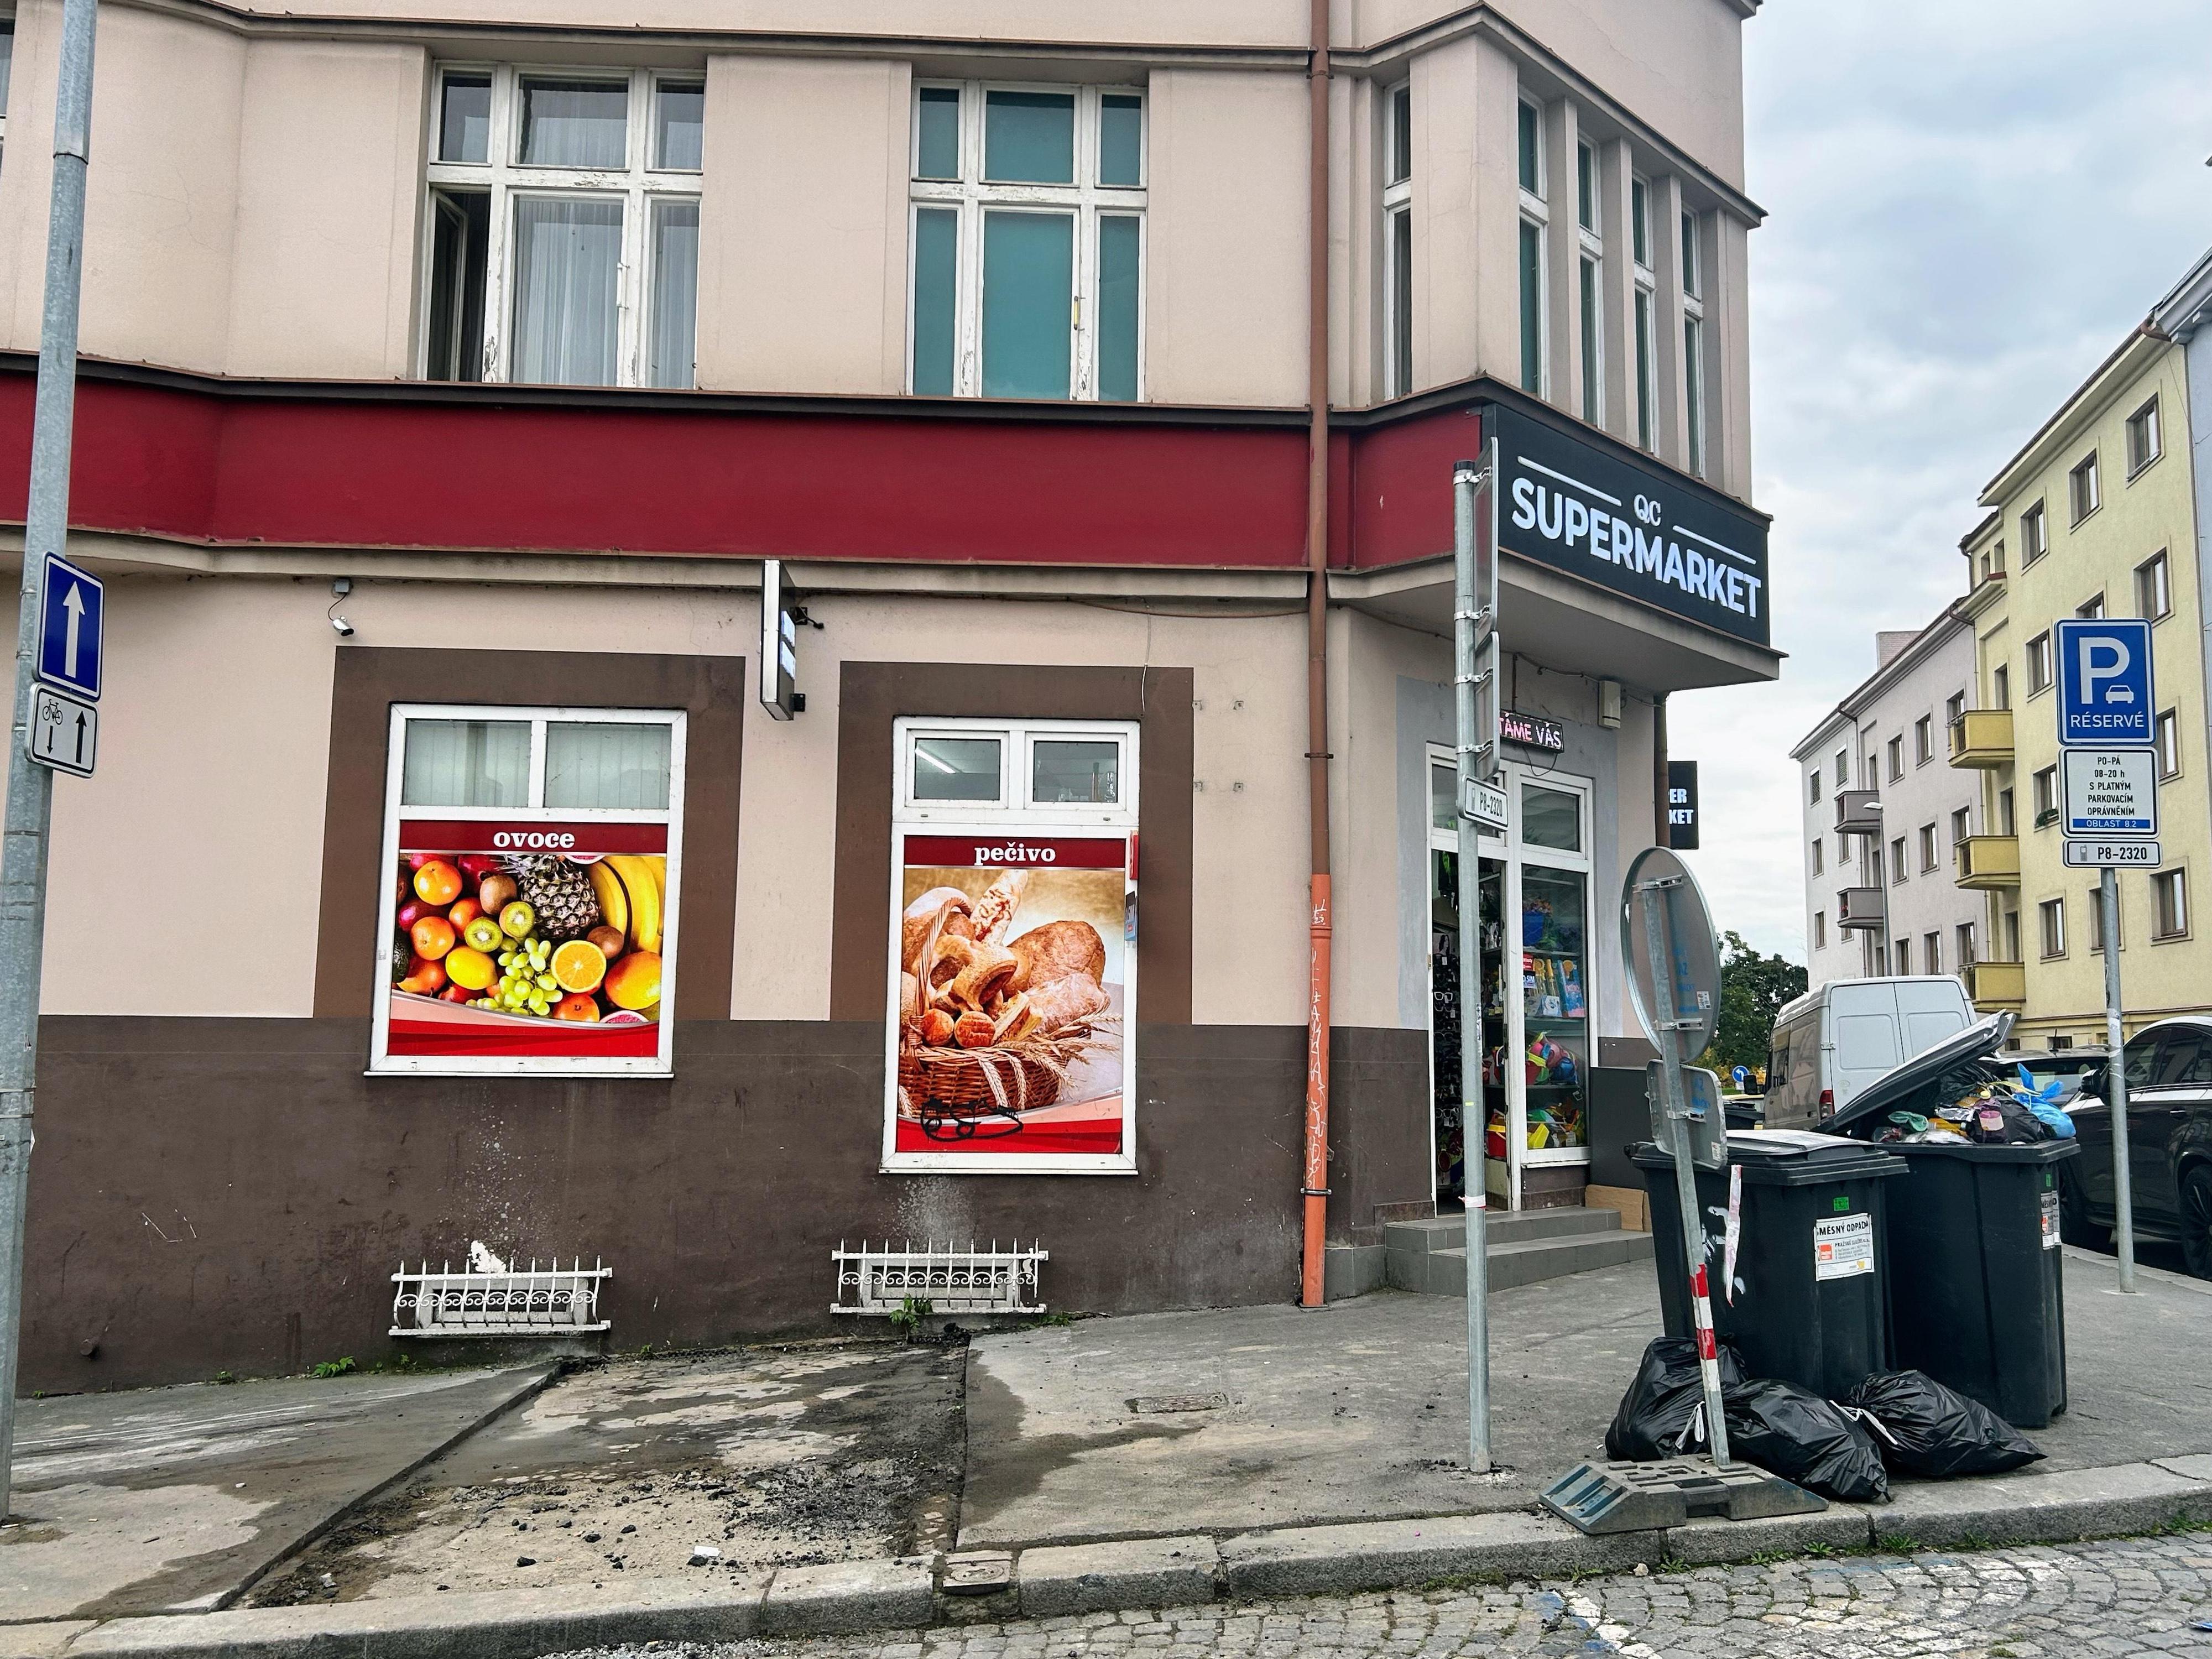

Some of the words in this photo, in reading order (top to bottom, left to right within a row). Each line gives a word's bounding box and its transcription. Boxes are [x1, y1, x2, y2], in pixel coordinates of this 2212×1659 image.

[1634, 494, 1661, 526] QC
[1511, 477, 1761, 618] SUPERMARKET
[2079, 637, 2130, 705] P
[2070, 711, 2145, 728] RÉSERVÉ
[1535, 722, 1561, 750] VÁS
[2096, 754, 2121, 766] PO-PÁ
[2094, 769, 2117, 778] 08-20
[2120, 769, 2125, 778] h
[2089, 781, 2095, 791] S
[2098, 779, 2132, 791] PLATNÝM
[1480, 791, 1503, 817] P8-2320
[1668, 788, 1687, 804] ER
[2088, 791, 2134, 804] PARKOVACÍM
[2087, 804, 2135, 816] OPRÁVNĚNÍM
[2086, 819, 2122, 828] OBLAST
[2124, 819, 2137, 828] 8.2
[493, 831, 576, 849] ovoce
[974, 841, 1056, 866] pečivo
[2097, 847, 2147, 860] P8-2320
